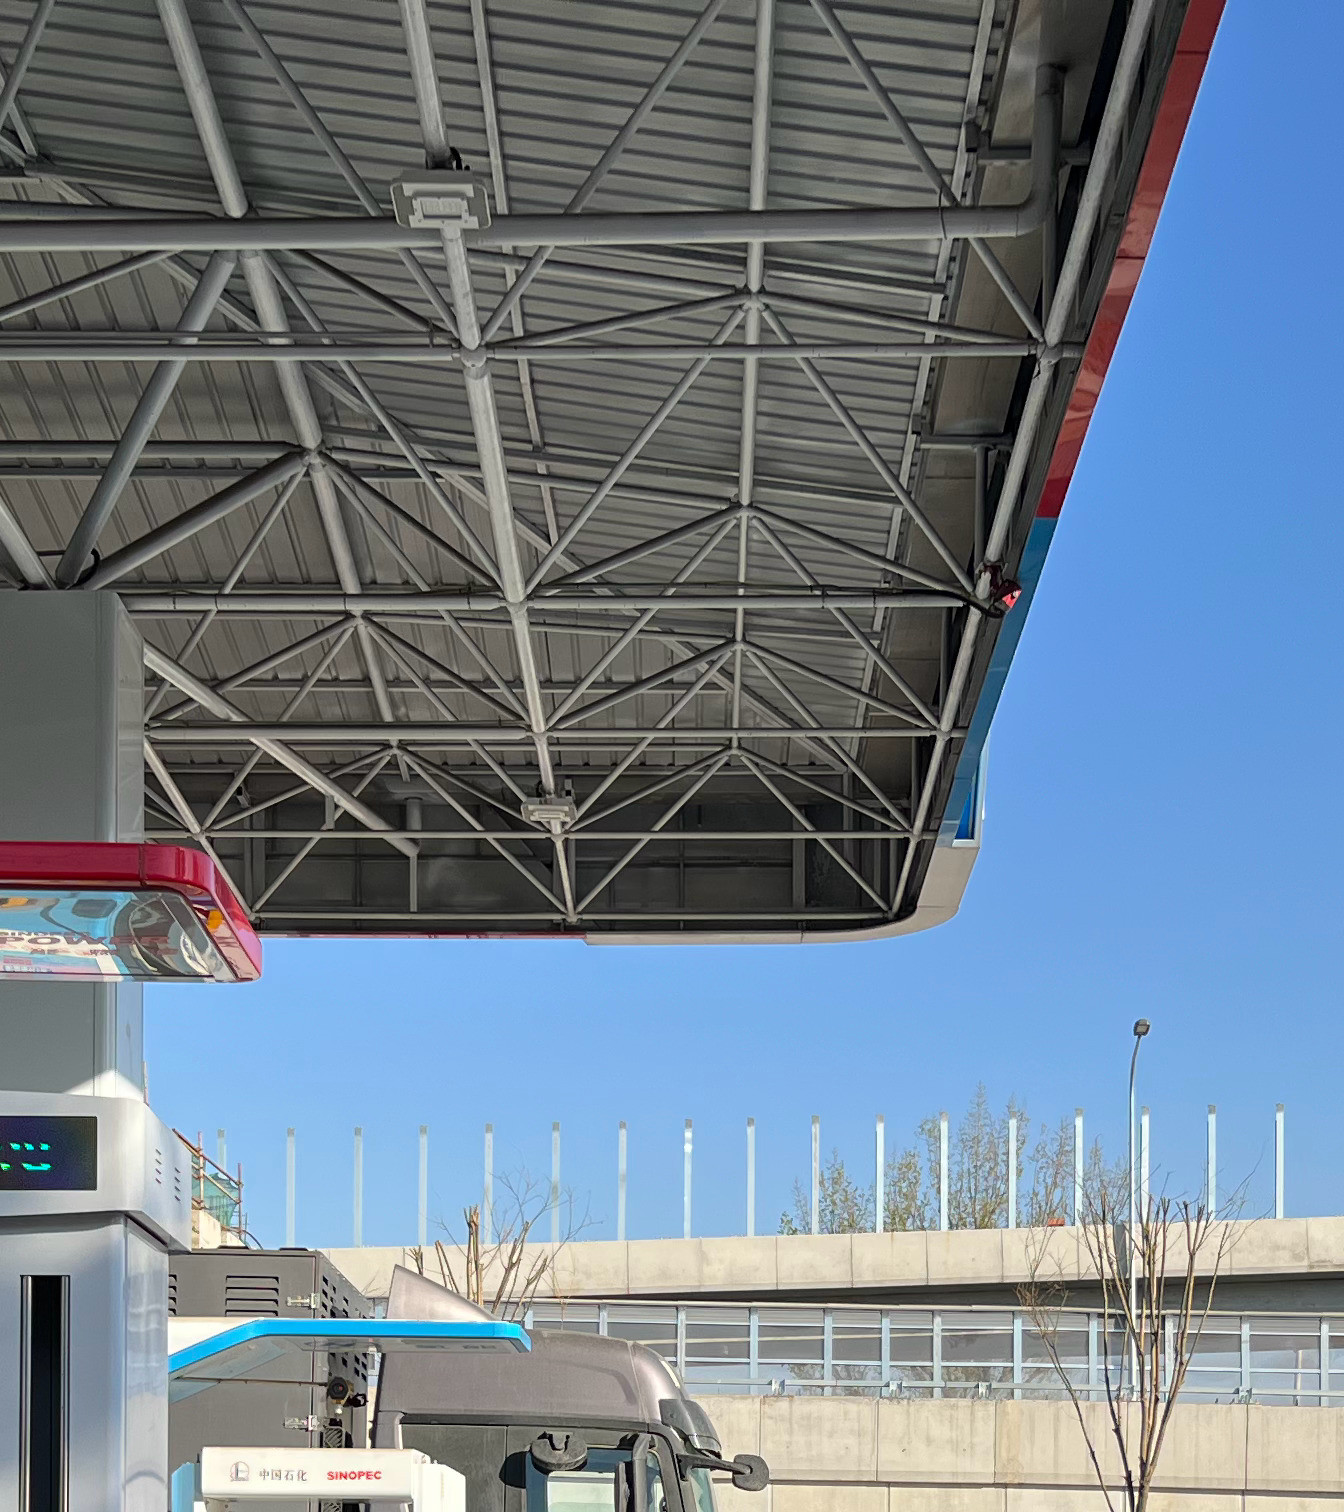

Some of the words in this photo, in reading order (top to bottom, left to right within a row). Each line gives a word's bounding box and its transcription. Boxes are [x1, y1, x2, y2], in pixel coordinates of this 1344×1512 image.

[258, 1468, 308, 1482] 中国石化
[326, 1470, 382, 1481] SINOPEC
